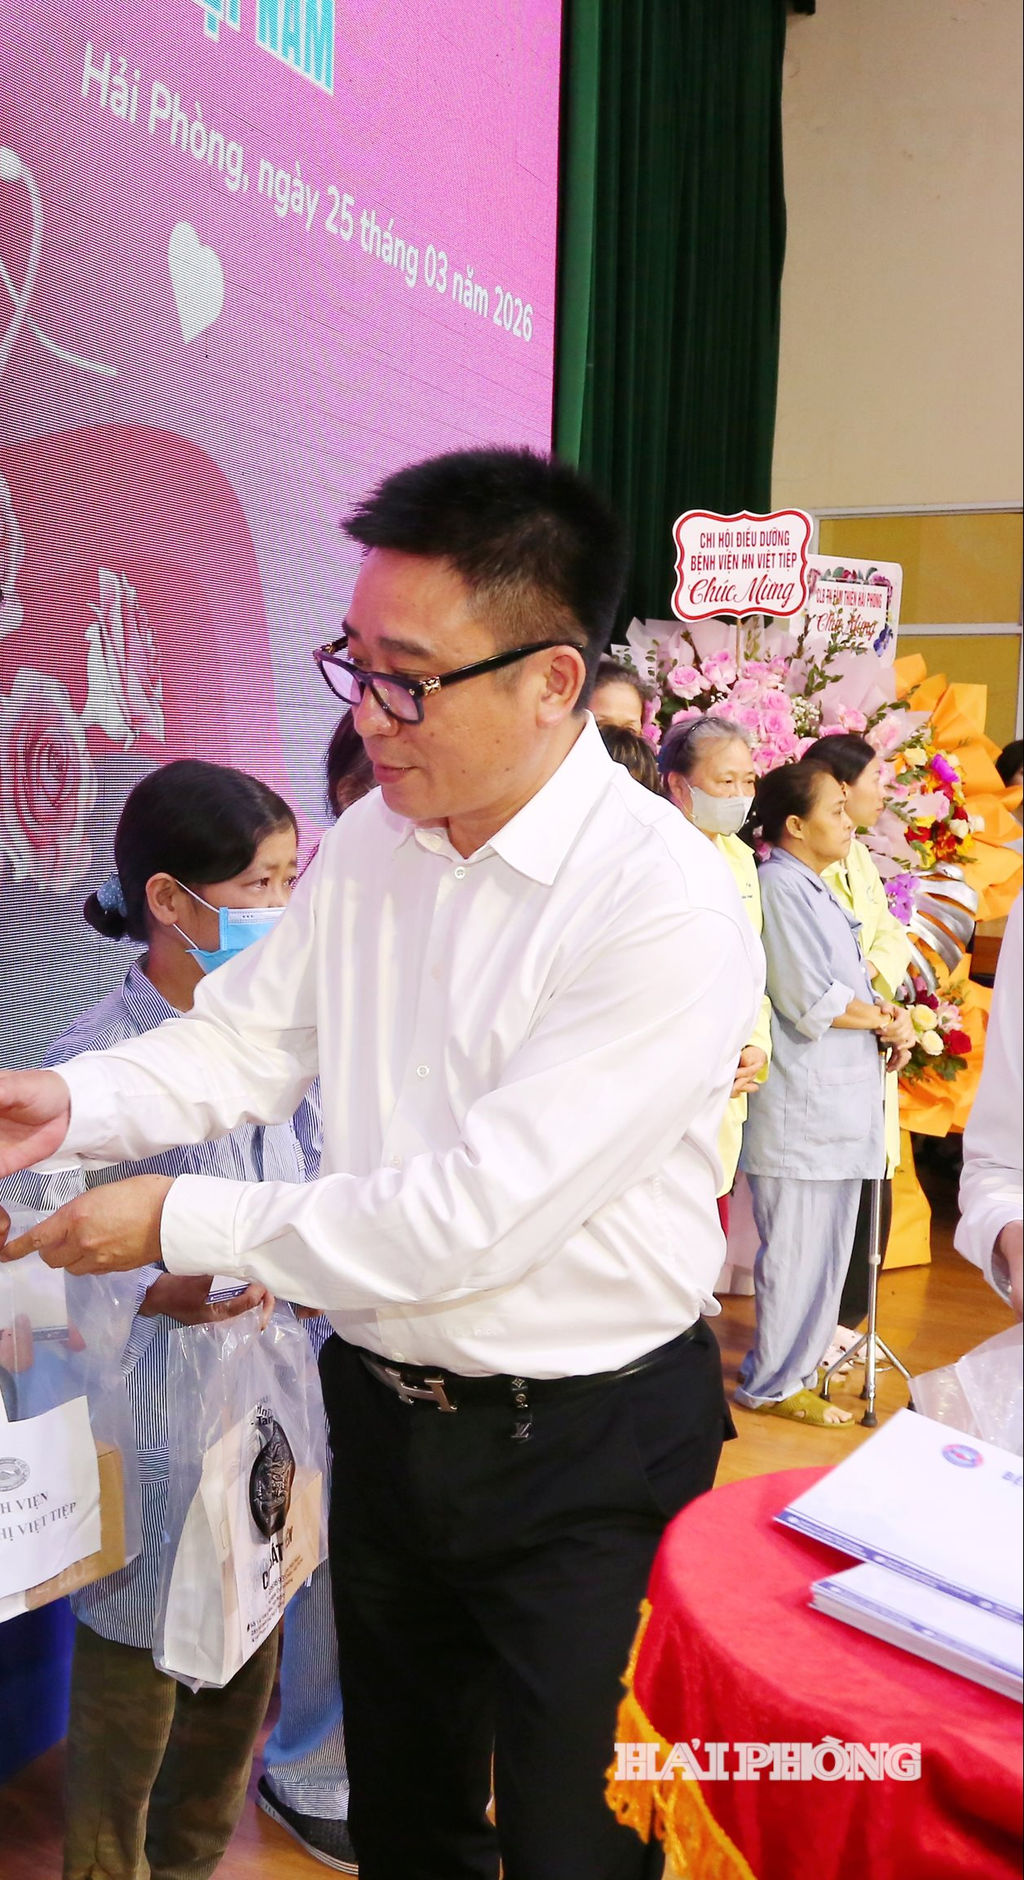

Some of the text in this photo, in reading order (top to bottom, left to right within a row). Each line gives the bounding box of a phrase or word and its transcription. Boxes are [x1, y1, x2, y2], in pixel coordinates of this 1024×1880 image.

[81, 41, 534, 342] Hải Phòng, ngày 25 tháng 03 năm 2026
[700, 532, 715, 548] CHI
[718, 528, 734, 552] HỘI
[690, 549, 797, 575] BỆNH VIỆN HN VIỆT TIỆP
[688, 574, 795, 608] Chúc Mừng
[16, 1491, 49, 1510] VIỆN
[18, 1514, 48, 1534] VIỆT
[50, 1502, 77, 1520] TIỆP
